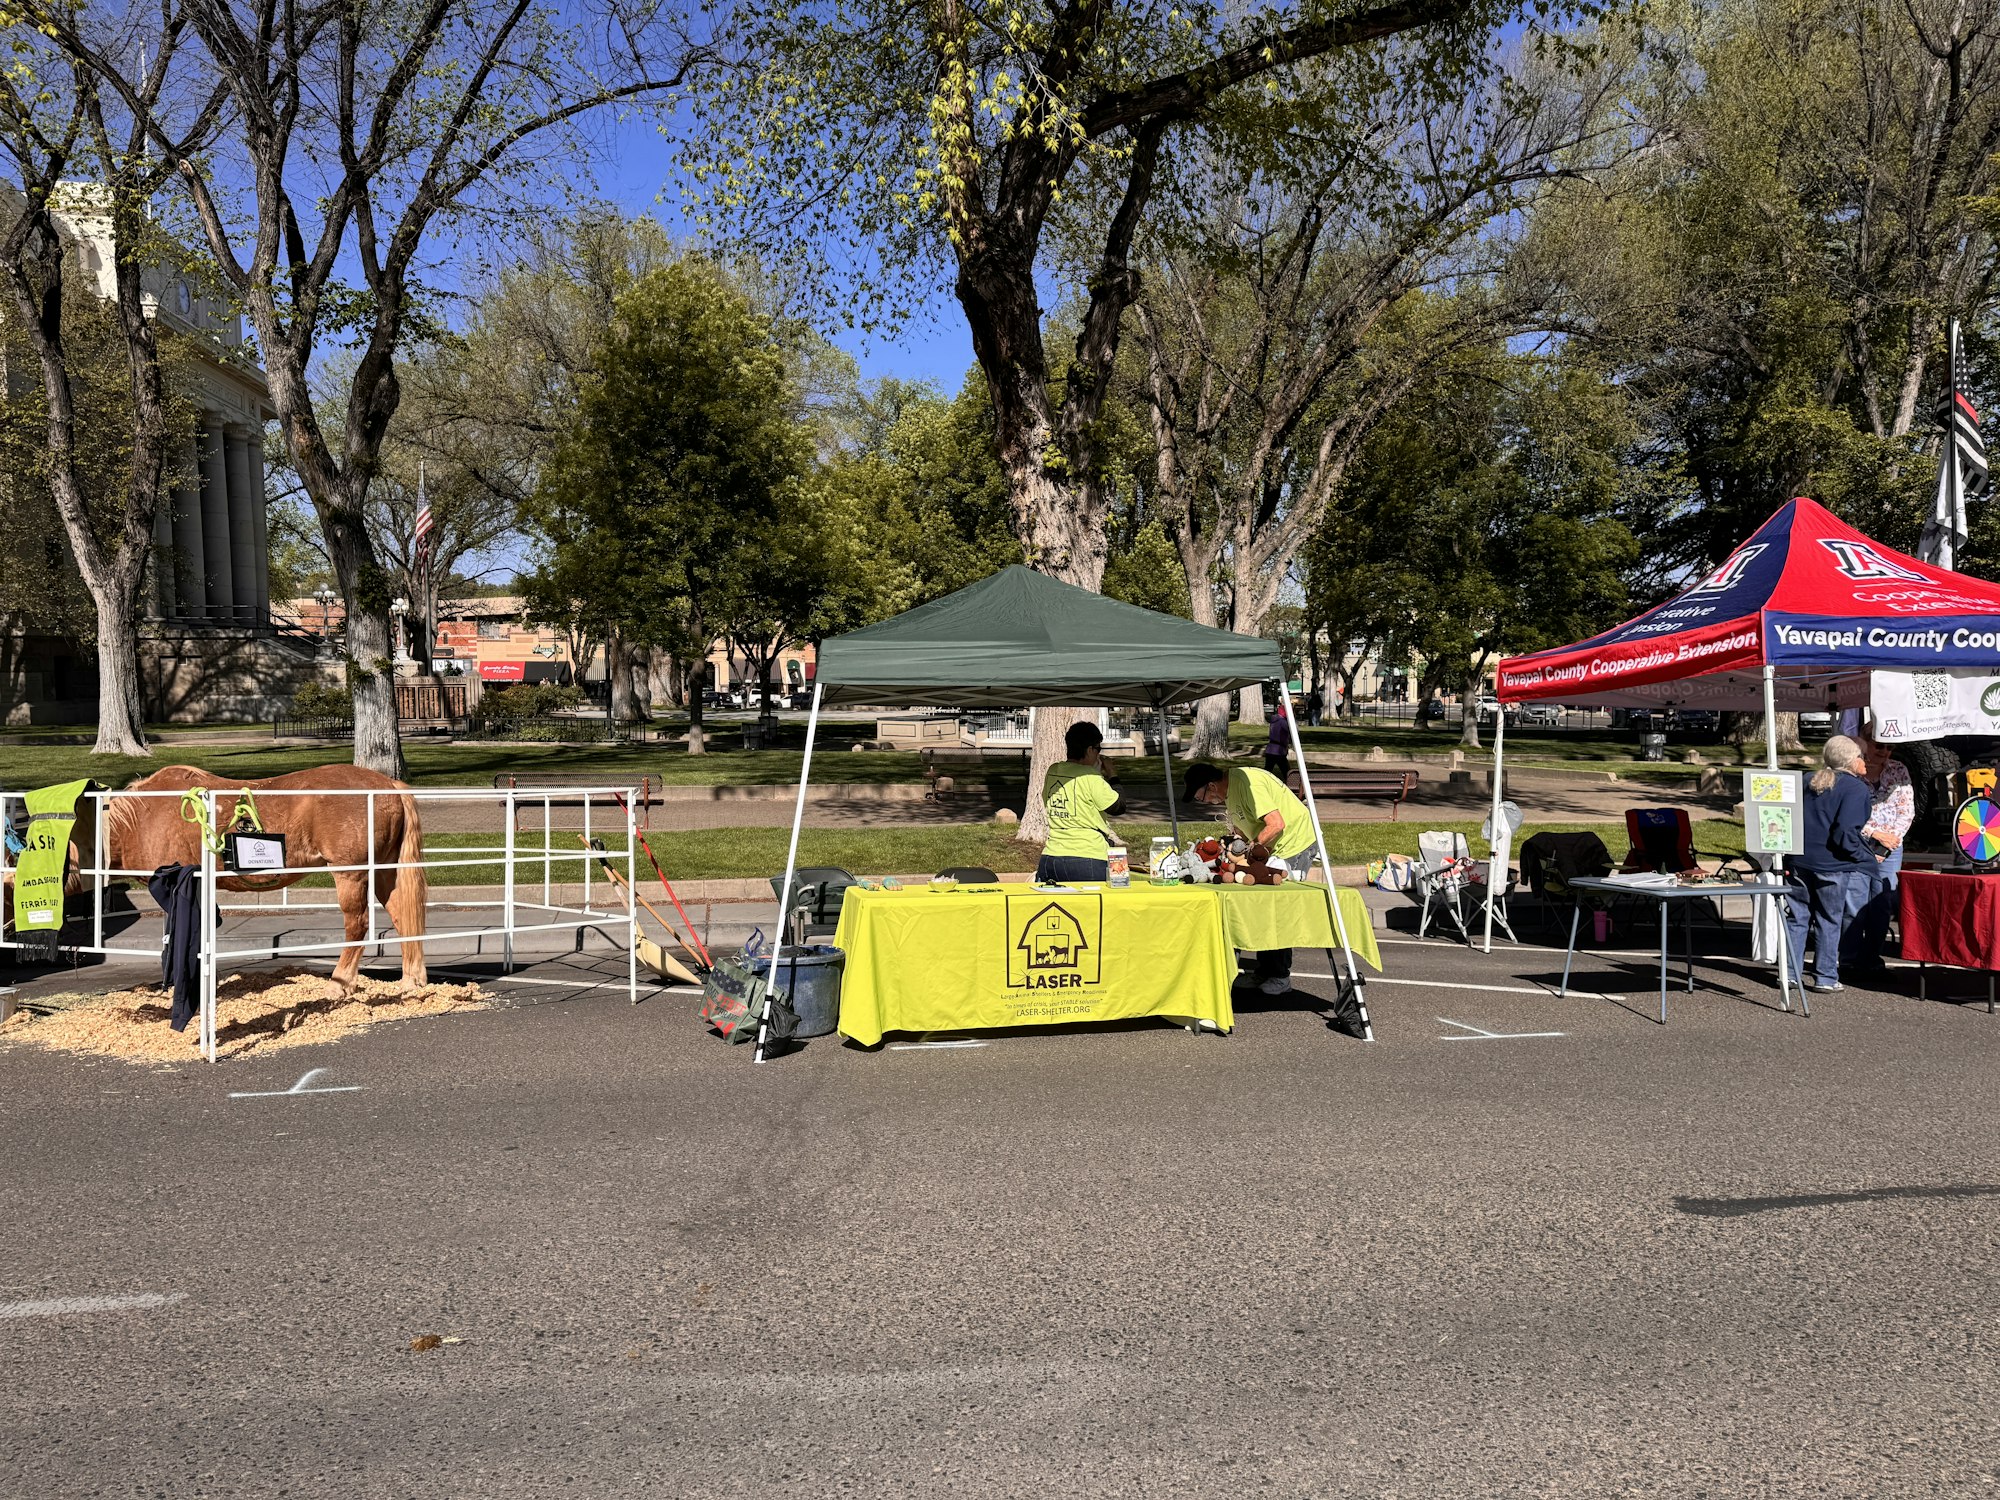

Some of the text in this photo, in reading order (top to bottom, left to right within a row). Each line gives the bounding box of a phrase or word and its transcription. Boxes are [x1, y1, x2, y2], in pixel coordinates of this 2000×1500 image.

[1774, 624, 1863, 650] Yavapai
[1867, 627, 1949, 652] County
[1501, 630, 1758, 688] Yavapai County Cooperative Extension
[1026, 973, 1083, 989] LASER
[1016, 1005, 1091, 1017] LASER-SHELTER.ORG
